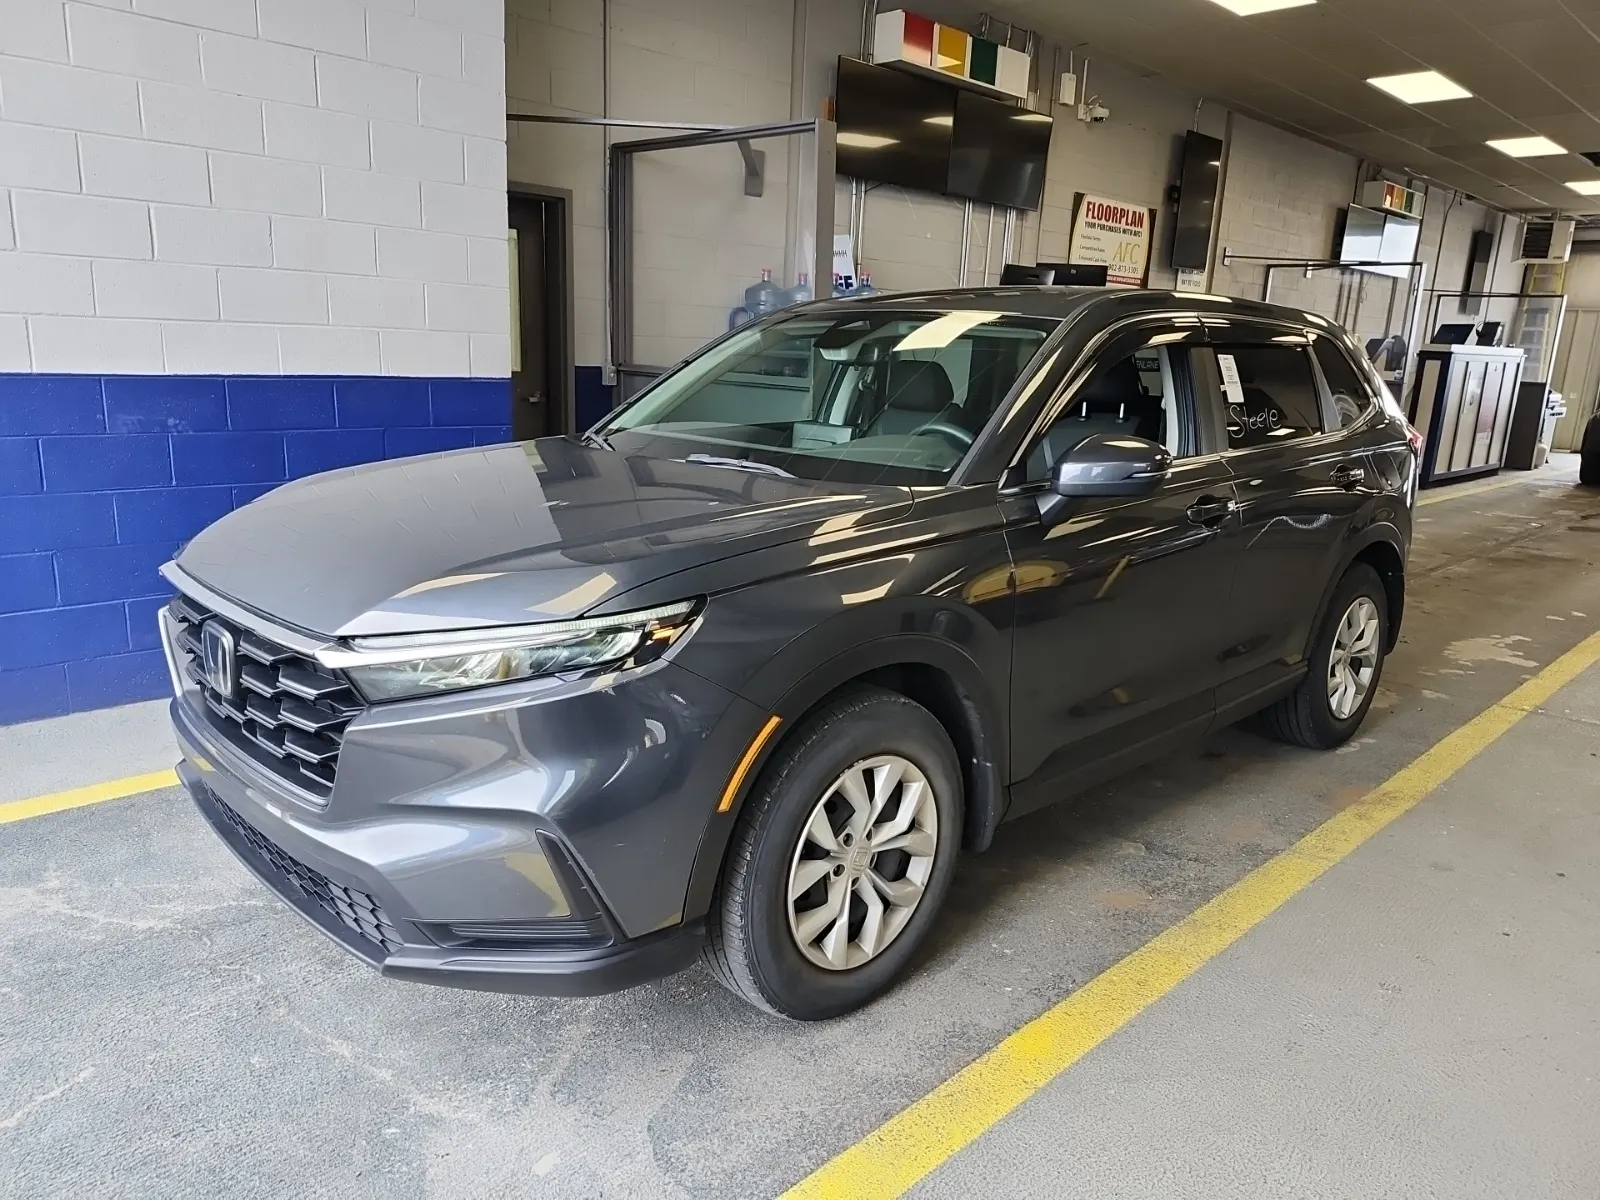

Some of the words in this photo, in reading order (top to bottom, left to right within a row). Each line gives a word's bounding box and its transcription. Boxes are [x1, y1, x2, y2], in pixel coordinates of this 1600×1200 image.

[1085, 201, 1145, 229] FLOORPLAN
[1084, 221, 1097, 231] YOUR
[1097, 223, 1122, 234] PURCHASES
[1122, 228, 1133, 237] WITH
[1112, 241, 1141, 264] AFC
[1229, 405, 1281, 438] Steele
